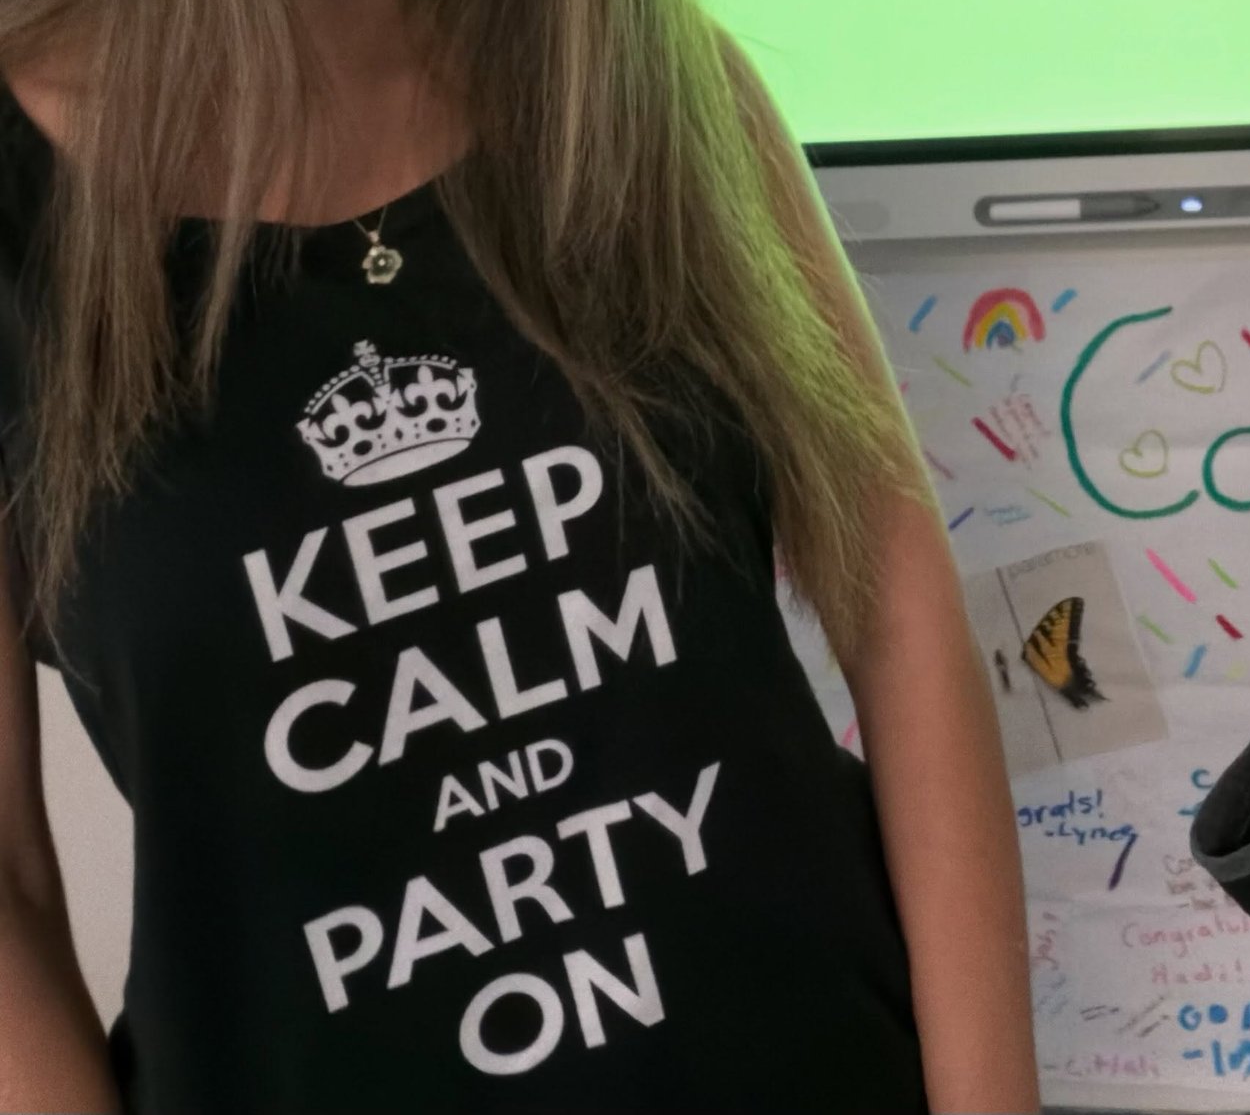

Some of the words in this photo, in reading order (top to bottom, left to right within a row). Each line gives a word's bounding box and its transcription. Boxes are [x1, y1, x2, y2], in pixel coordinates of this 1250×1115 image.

[243, 445, 603, 662] KEEP
[264, 563, 677, 792] CALM
[433, 738, 575, 832] AND
[304, 761, 720, 1013] PARTY
[459, 933, 665, 1075] ON
